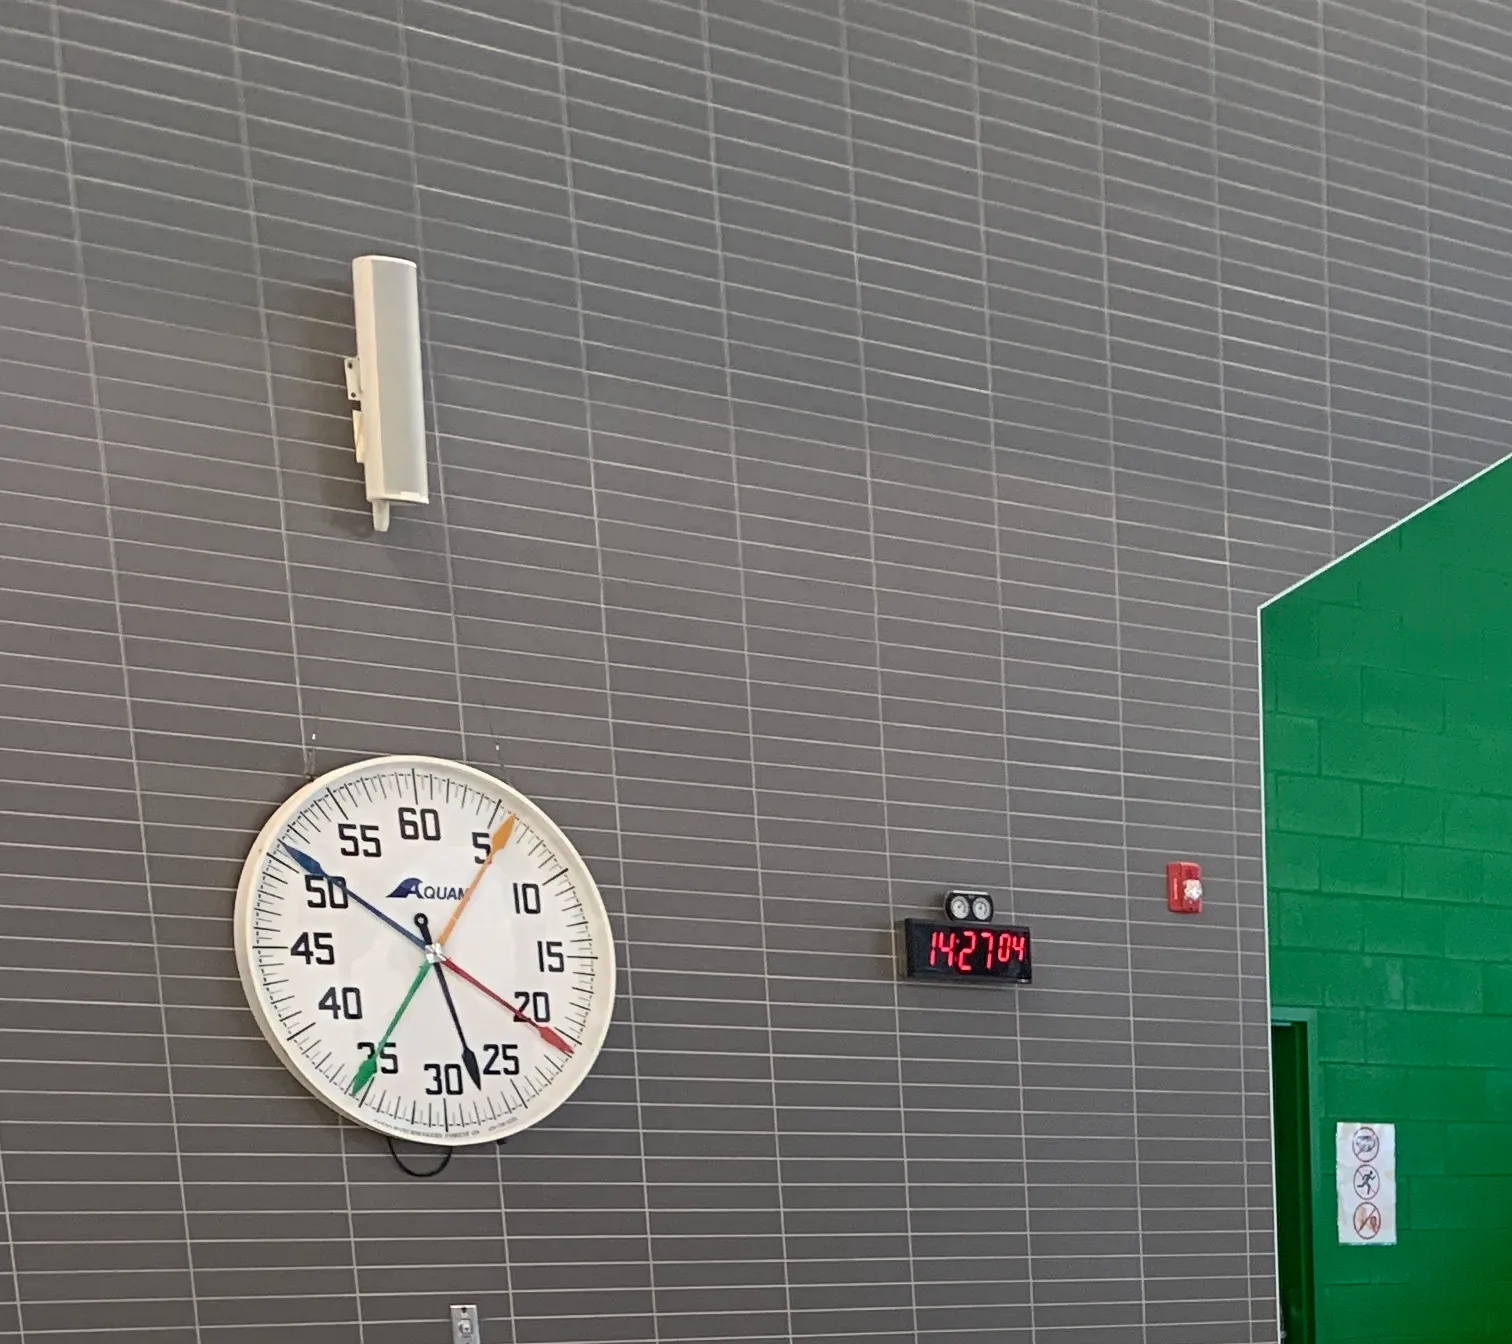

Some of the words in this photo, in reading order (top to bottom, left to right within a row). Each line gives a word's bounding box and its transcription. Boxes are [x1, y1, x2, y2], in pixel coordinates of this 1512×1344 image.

[338, 823, 381, 858] 55
[397, 807, 441, 841] 60
[472, 831, 491, 864] 5
[305, 875, 349, 909] 50
[512, 882, 541, 915] 10
[290, 932, 335, 966] 45
[537, 940, 565, 973] 15
[998, 933, 1025, 962] 04
[318, 986, 363, 1020] 40
[513, 992, 551, 1023] 20
[482, 1044, 520, 1075] 25
[423, 1063, 464, 1096] 30
